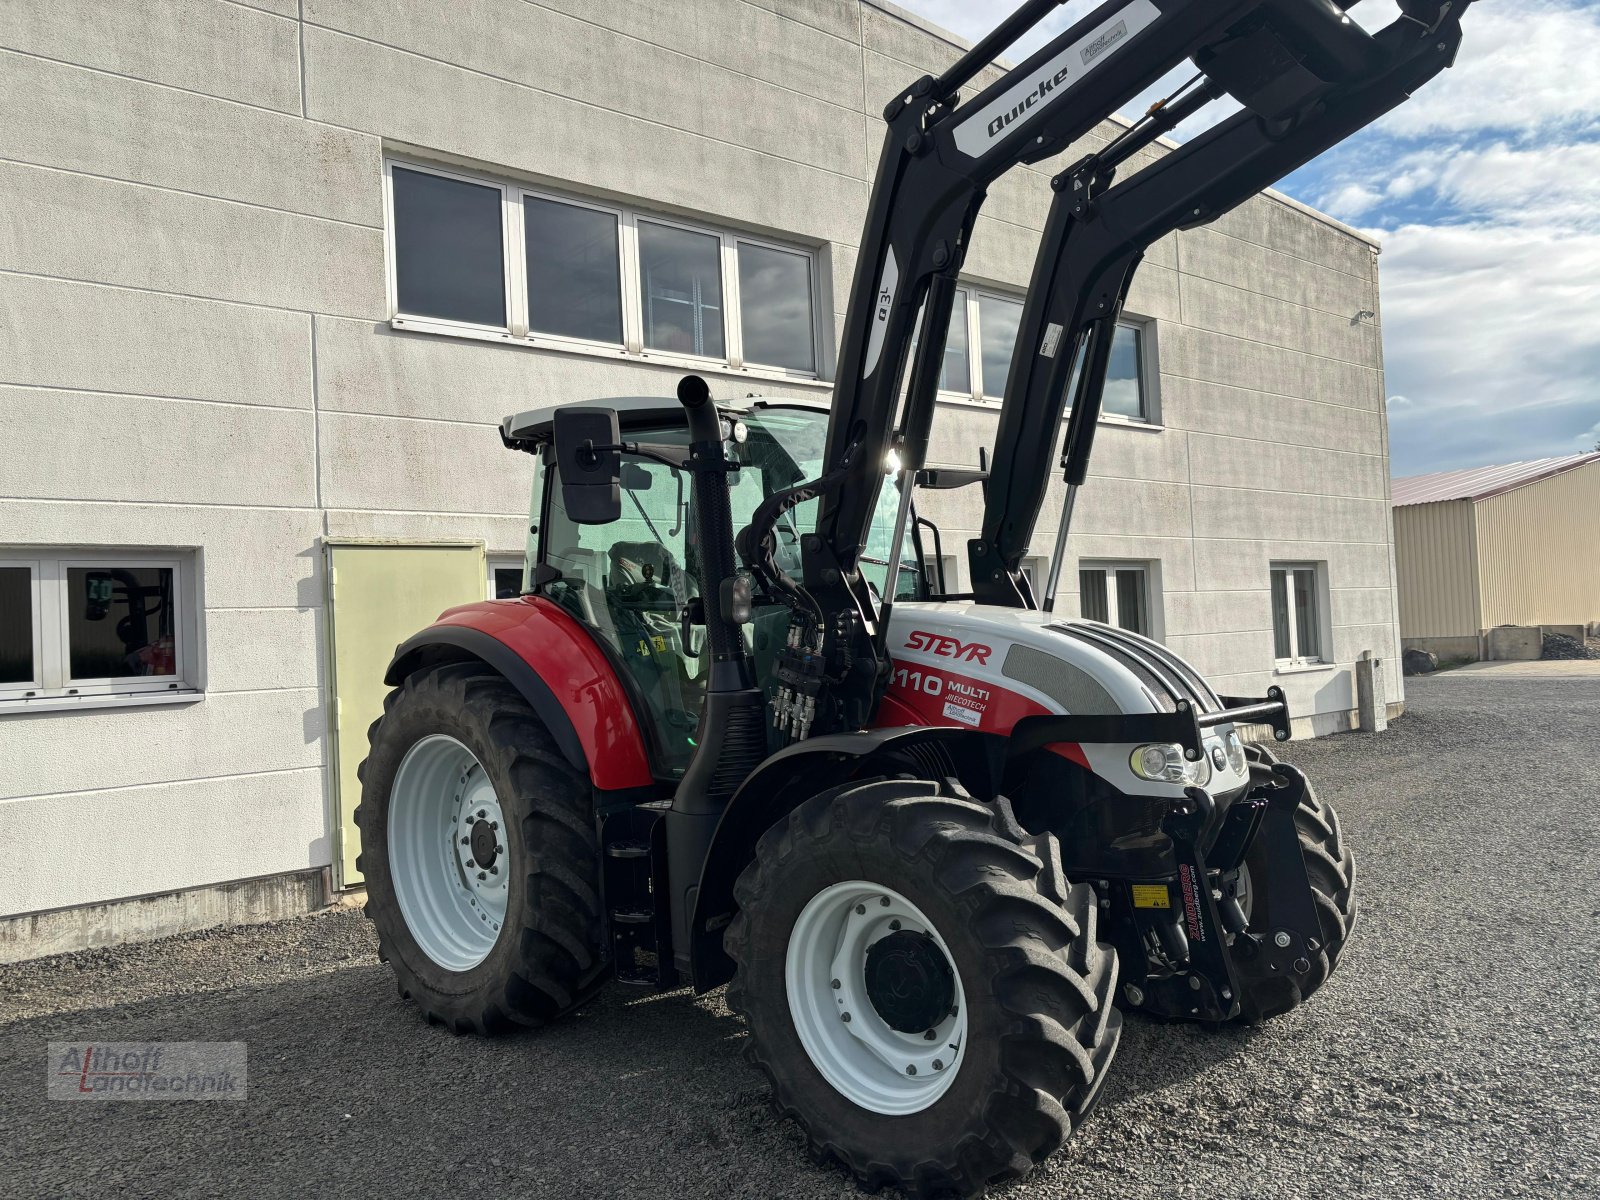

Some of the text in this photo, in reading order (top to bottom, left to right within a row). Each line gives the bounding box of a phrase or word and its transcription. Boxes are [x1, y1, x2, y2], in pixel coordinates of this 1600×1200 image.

[987, 66, 1068, 138] Quicke
[904, 630, 992, 666] STEYR
[947, 680, 990, 701] MULTI
[1179, 863, 1200, 941] ZUIDBERG
[1189, 865, 1206, 942] www.zuidberg.com
